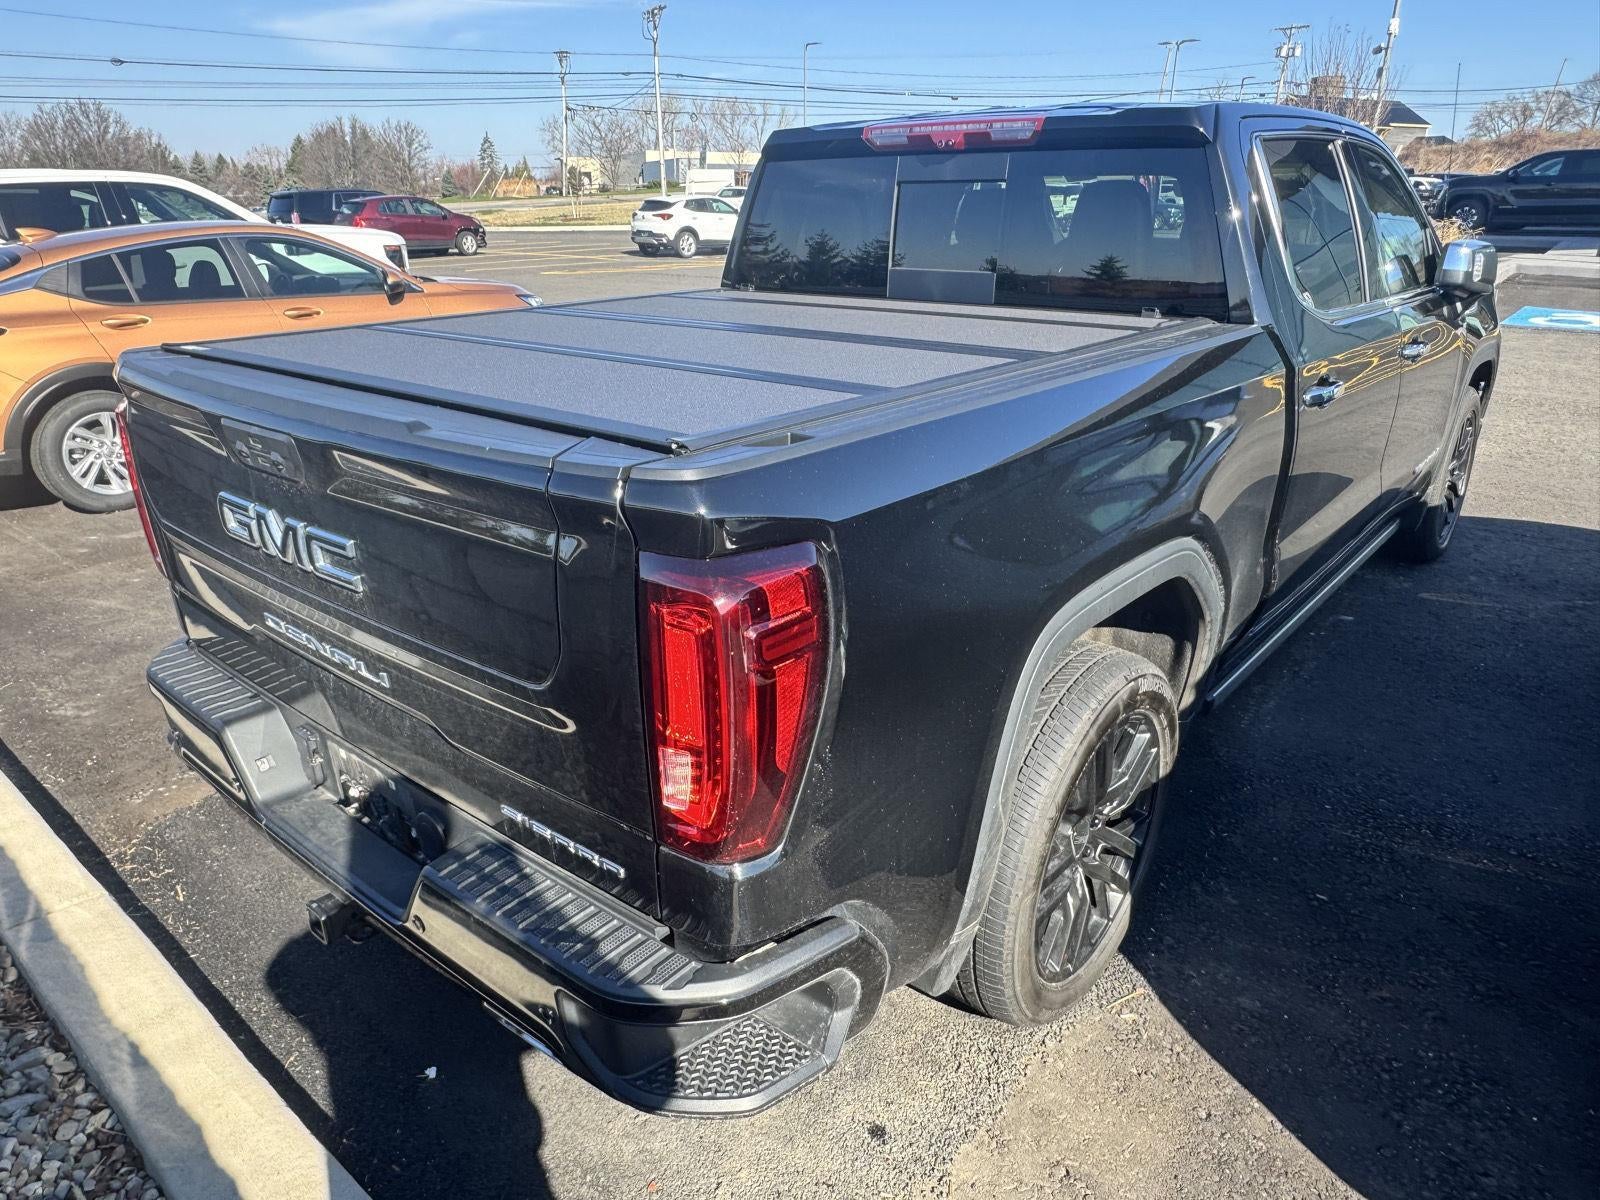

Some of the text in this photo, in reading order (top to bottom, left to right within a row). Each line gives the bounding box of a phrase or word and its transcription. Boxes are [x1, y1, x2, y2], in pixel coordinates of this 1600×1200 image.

[217, 491, 364, 594] GMC
[263, 611, 390, 689] DENALI
[500, 803, 626, 879] SIERRA
